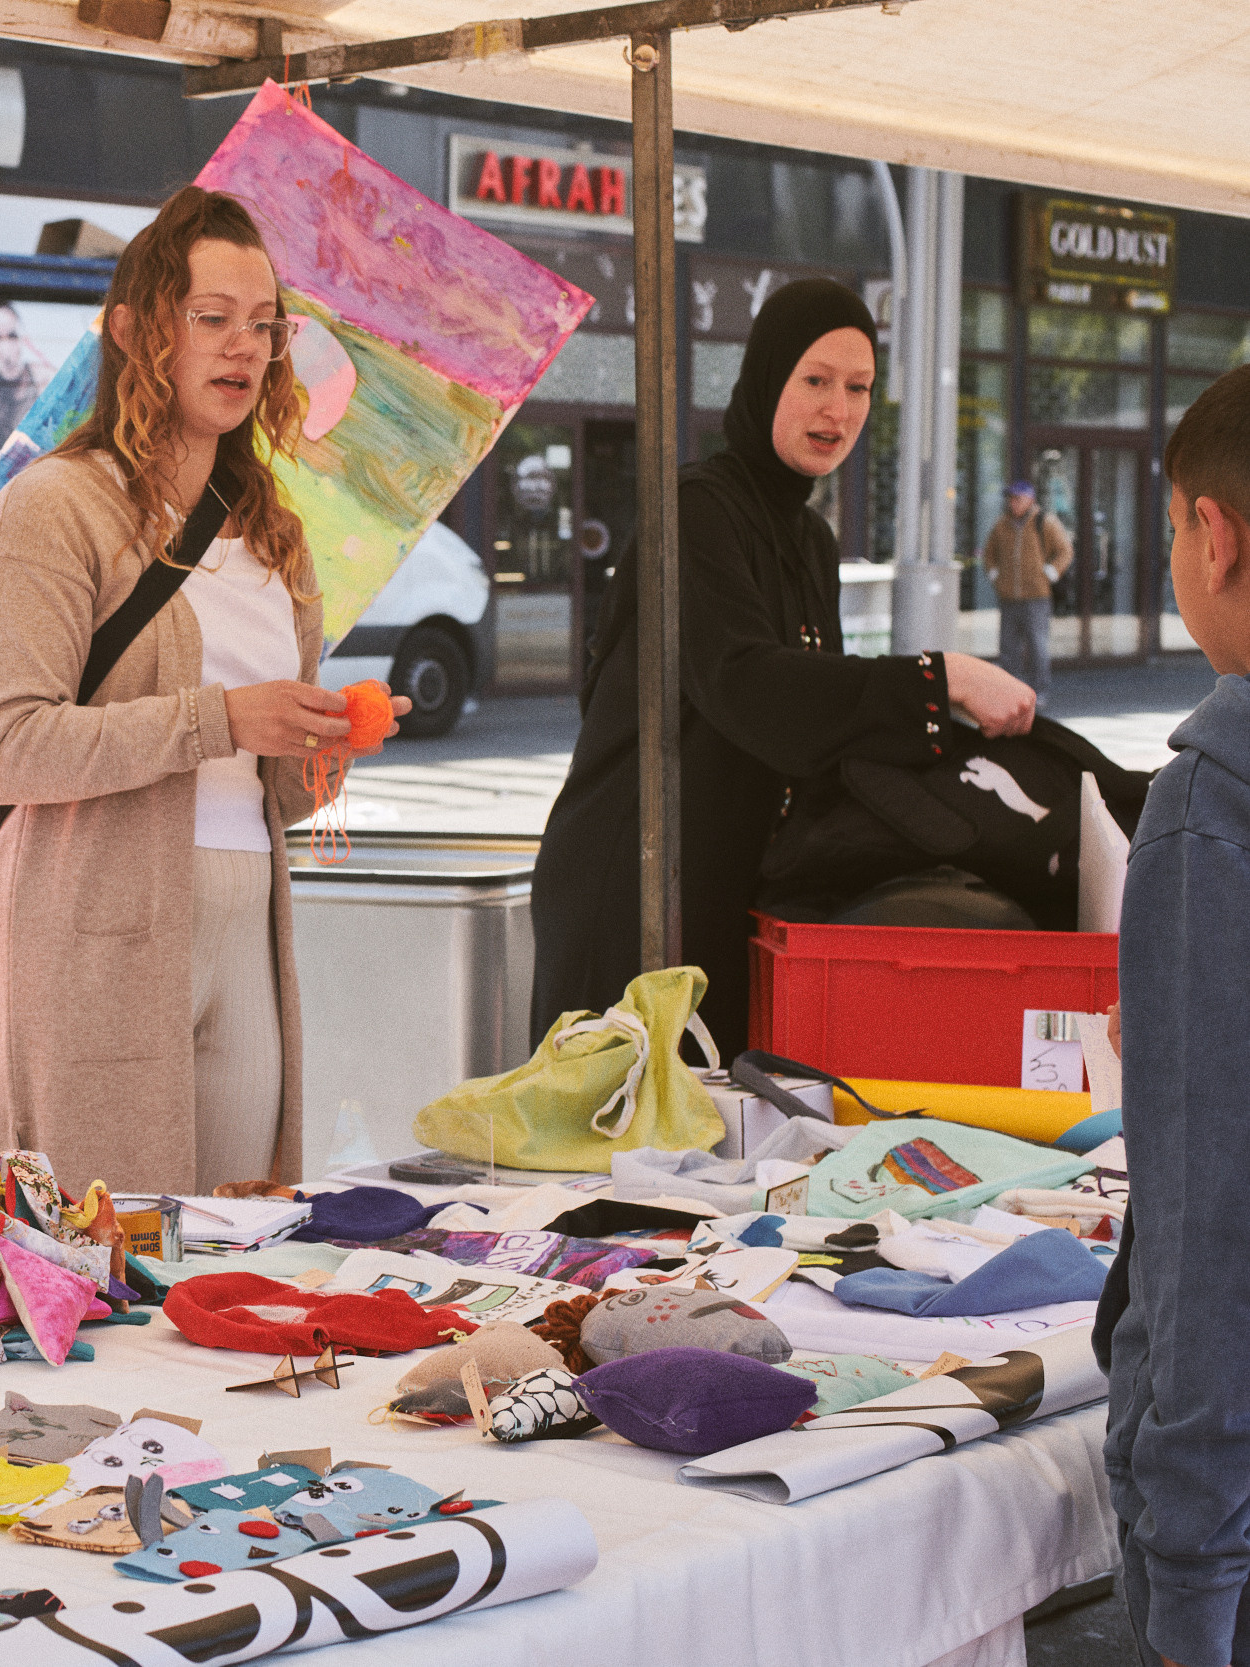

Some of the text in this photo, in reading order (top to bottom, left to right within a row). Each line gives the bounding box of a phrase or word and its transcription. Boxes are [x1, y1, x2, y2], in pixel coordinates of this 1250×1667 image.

[476, 151, 626, 217] AFRAH
[1050, 221, 1167, 267] GOLD DUST
[130, 1231, 161, 1242] 50mm
[140, 1242, 161, 1252] 50m
